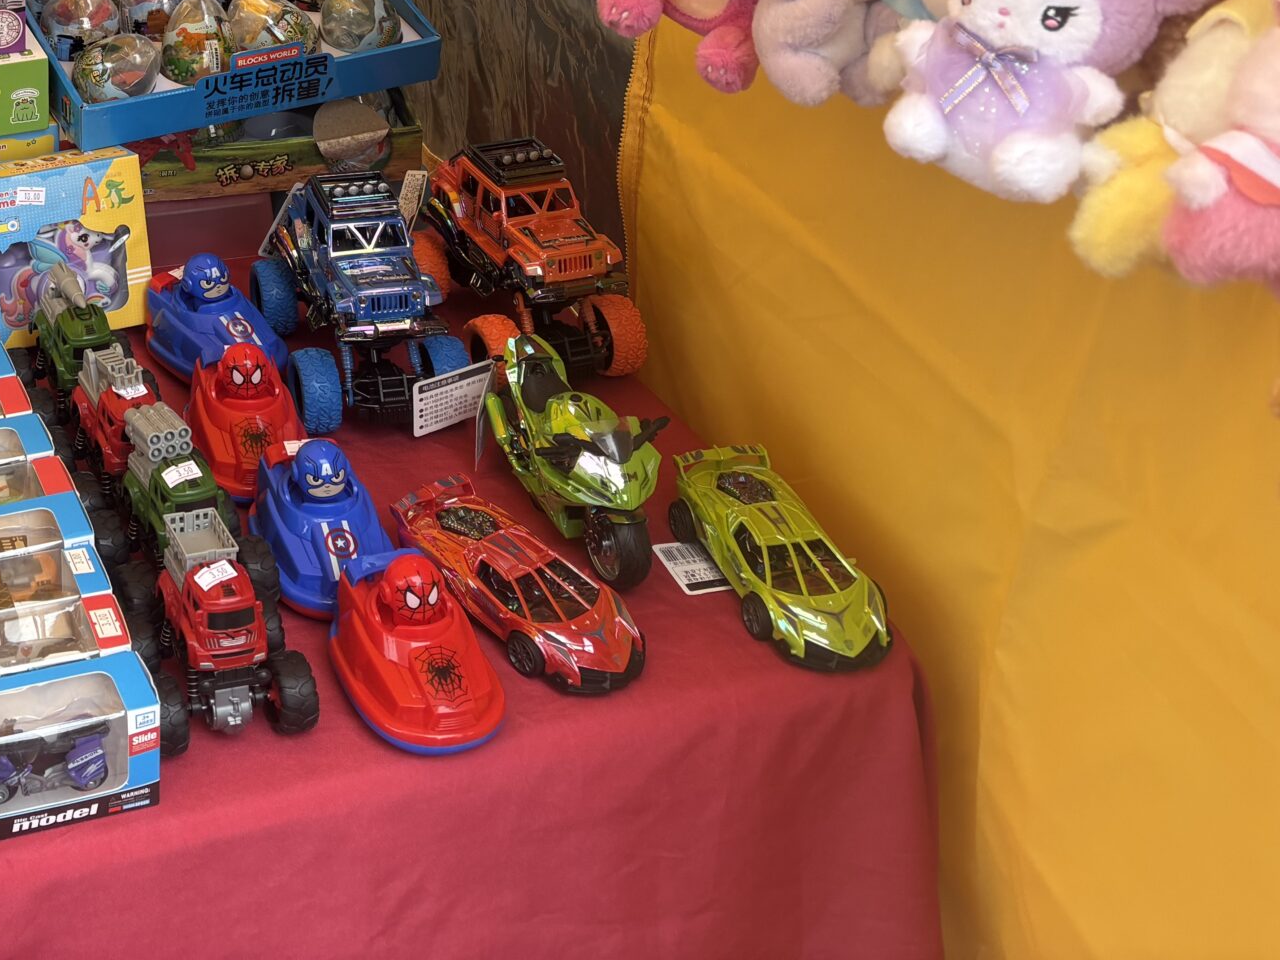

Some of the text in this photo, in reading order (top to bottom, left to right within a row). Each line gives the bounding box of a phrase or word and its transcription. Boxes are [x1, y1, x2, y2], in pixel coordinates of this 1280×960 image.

[237, 49, 298, 66] BLOCKS WORLD
[204, 56, 328, 100] 火车总动员
[175, 466, 194, 477] 3.50
[210, 567, 229, 579] 3.50
[132, 731, 157, 746] Slide
[12, 803, 99, 833] model
[29, 812, 48, 823] Cast
